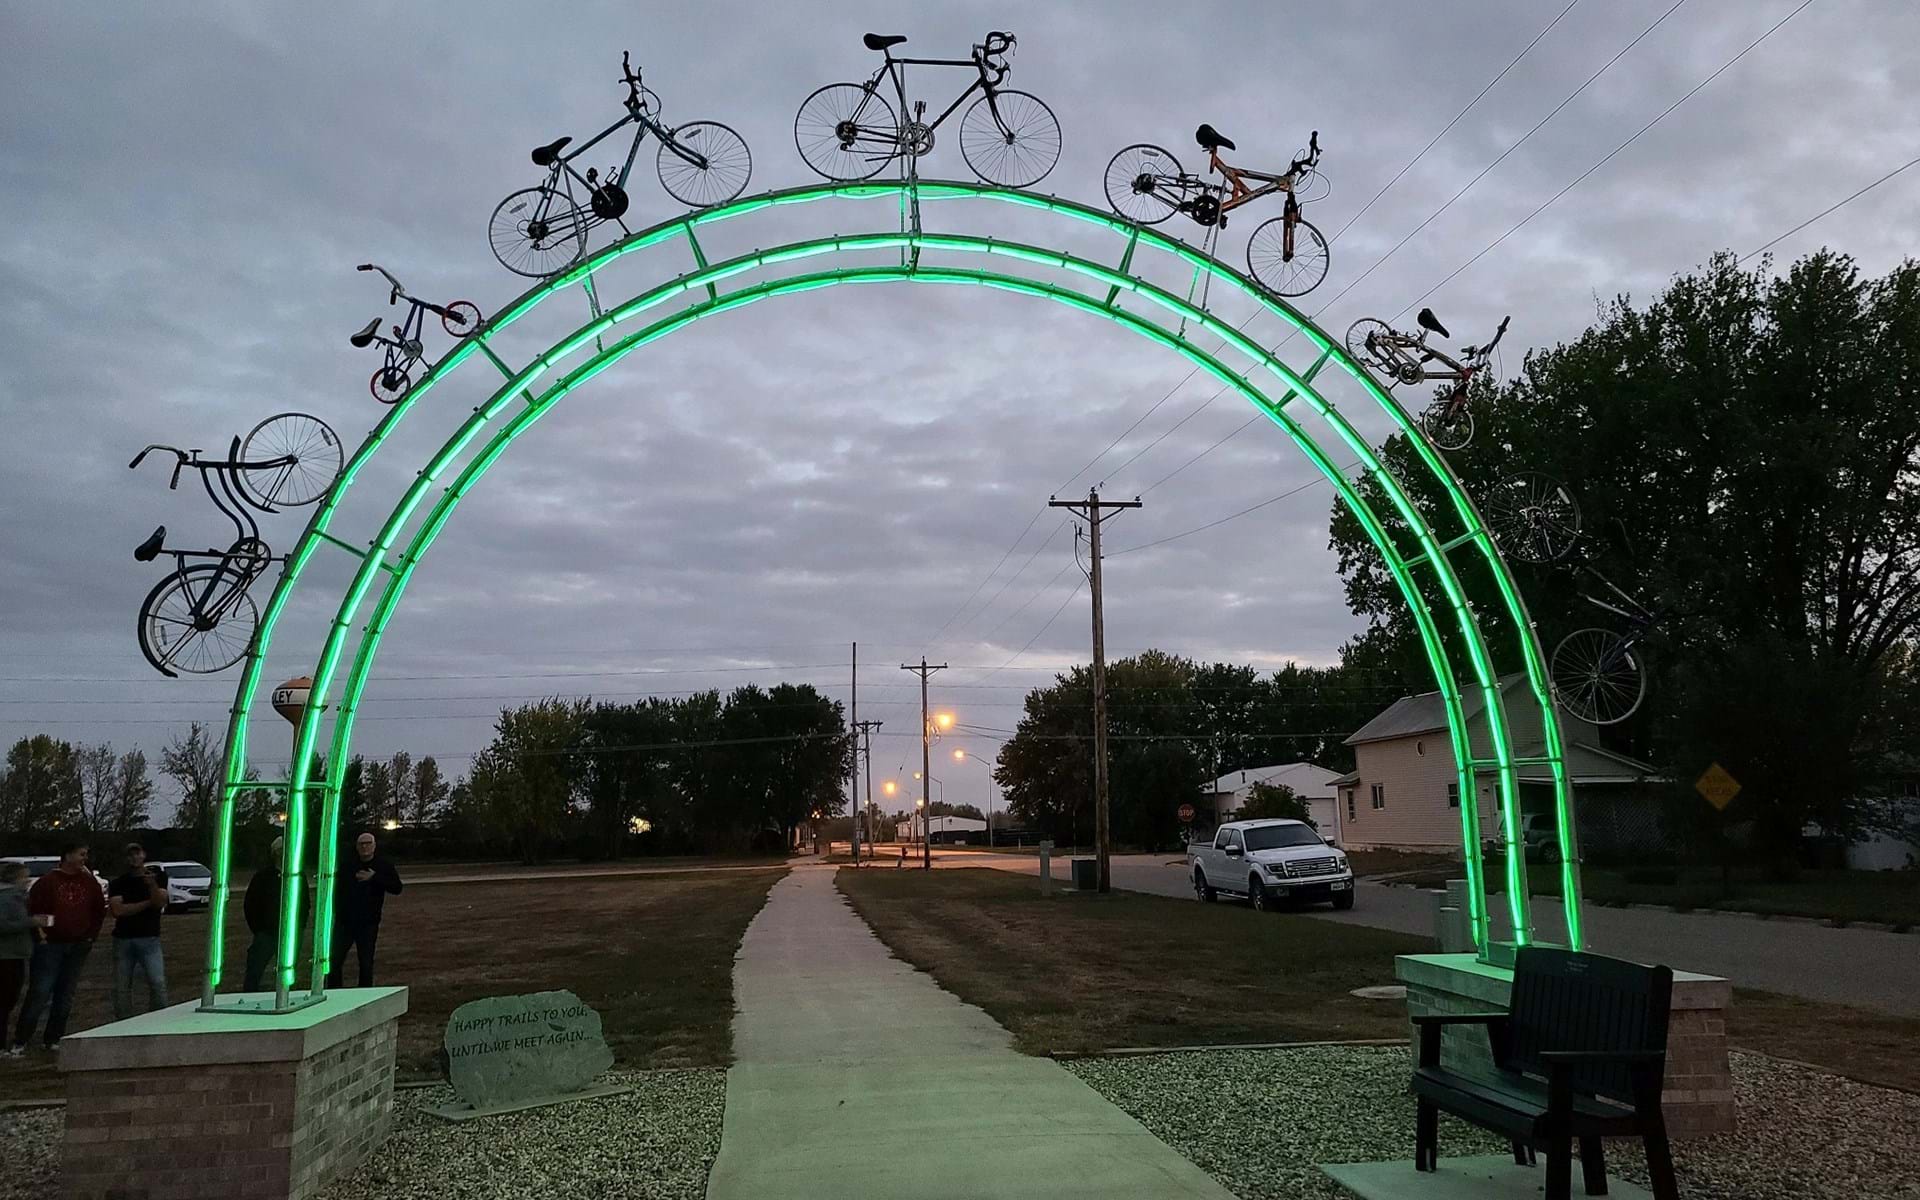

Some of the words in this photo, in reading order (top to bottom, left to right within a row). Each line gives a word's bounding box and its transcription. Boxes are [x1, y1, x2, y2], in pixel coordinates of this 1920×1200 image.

[272, 691, 293, 704] LEY
[1178, 809, 1193, 817] STOP
[455, 1017, 495, 1032] HAPPY
[498, 1011, 539, 1026] TRAILS
[543, 1008, 559, 1021] TO
[451, 1042, 491, 1058] UNTIL
[493, 1039, 511, 1051] WE
[514, 1035, 544, 1048] MEET
